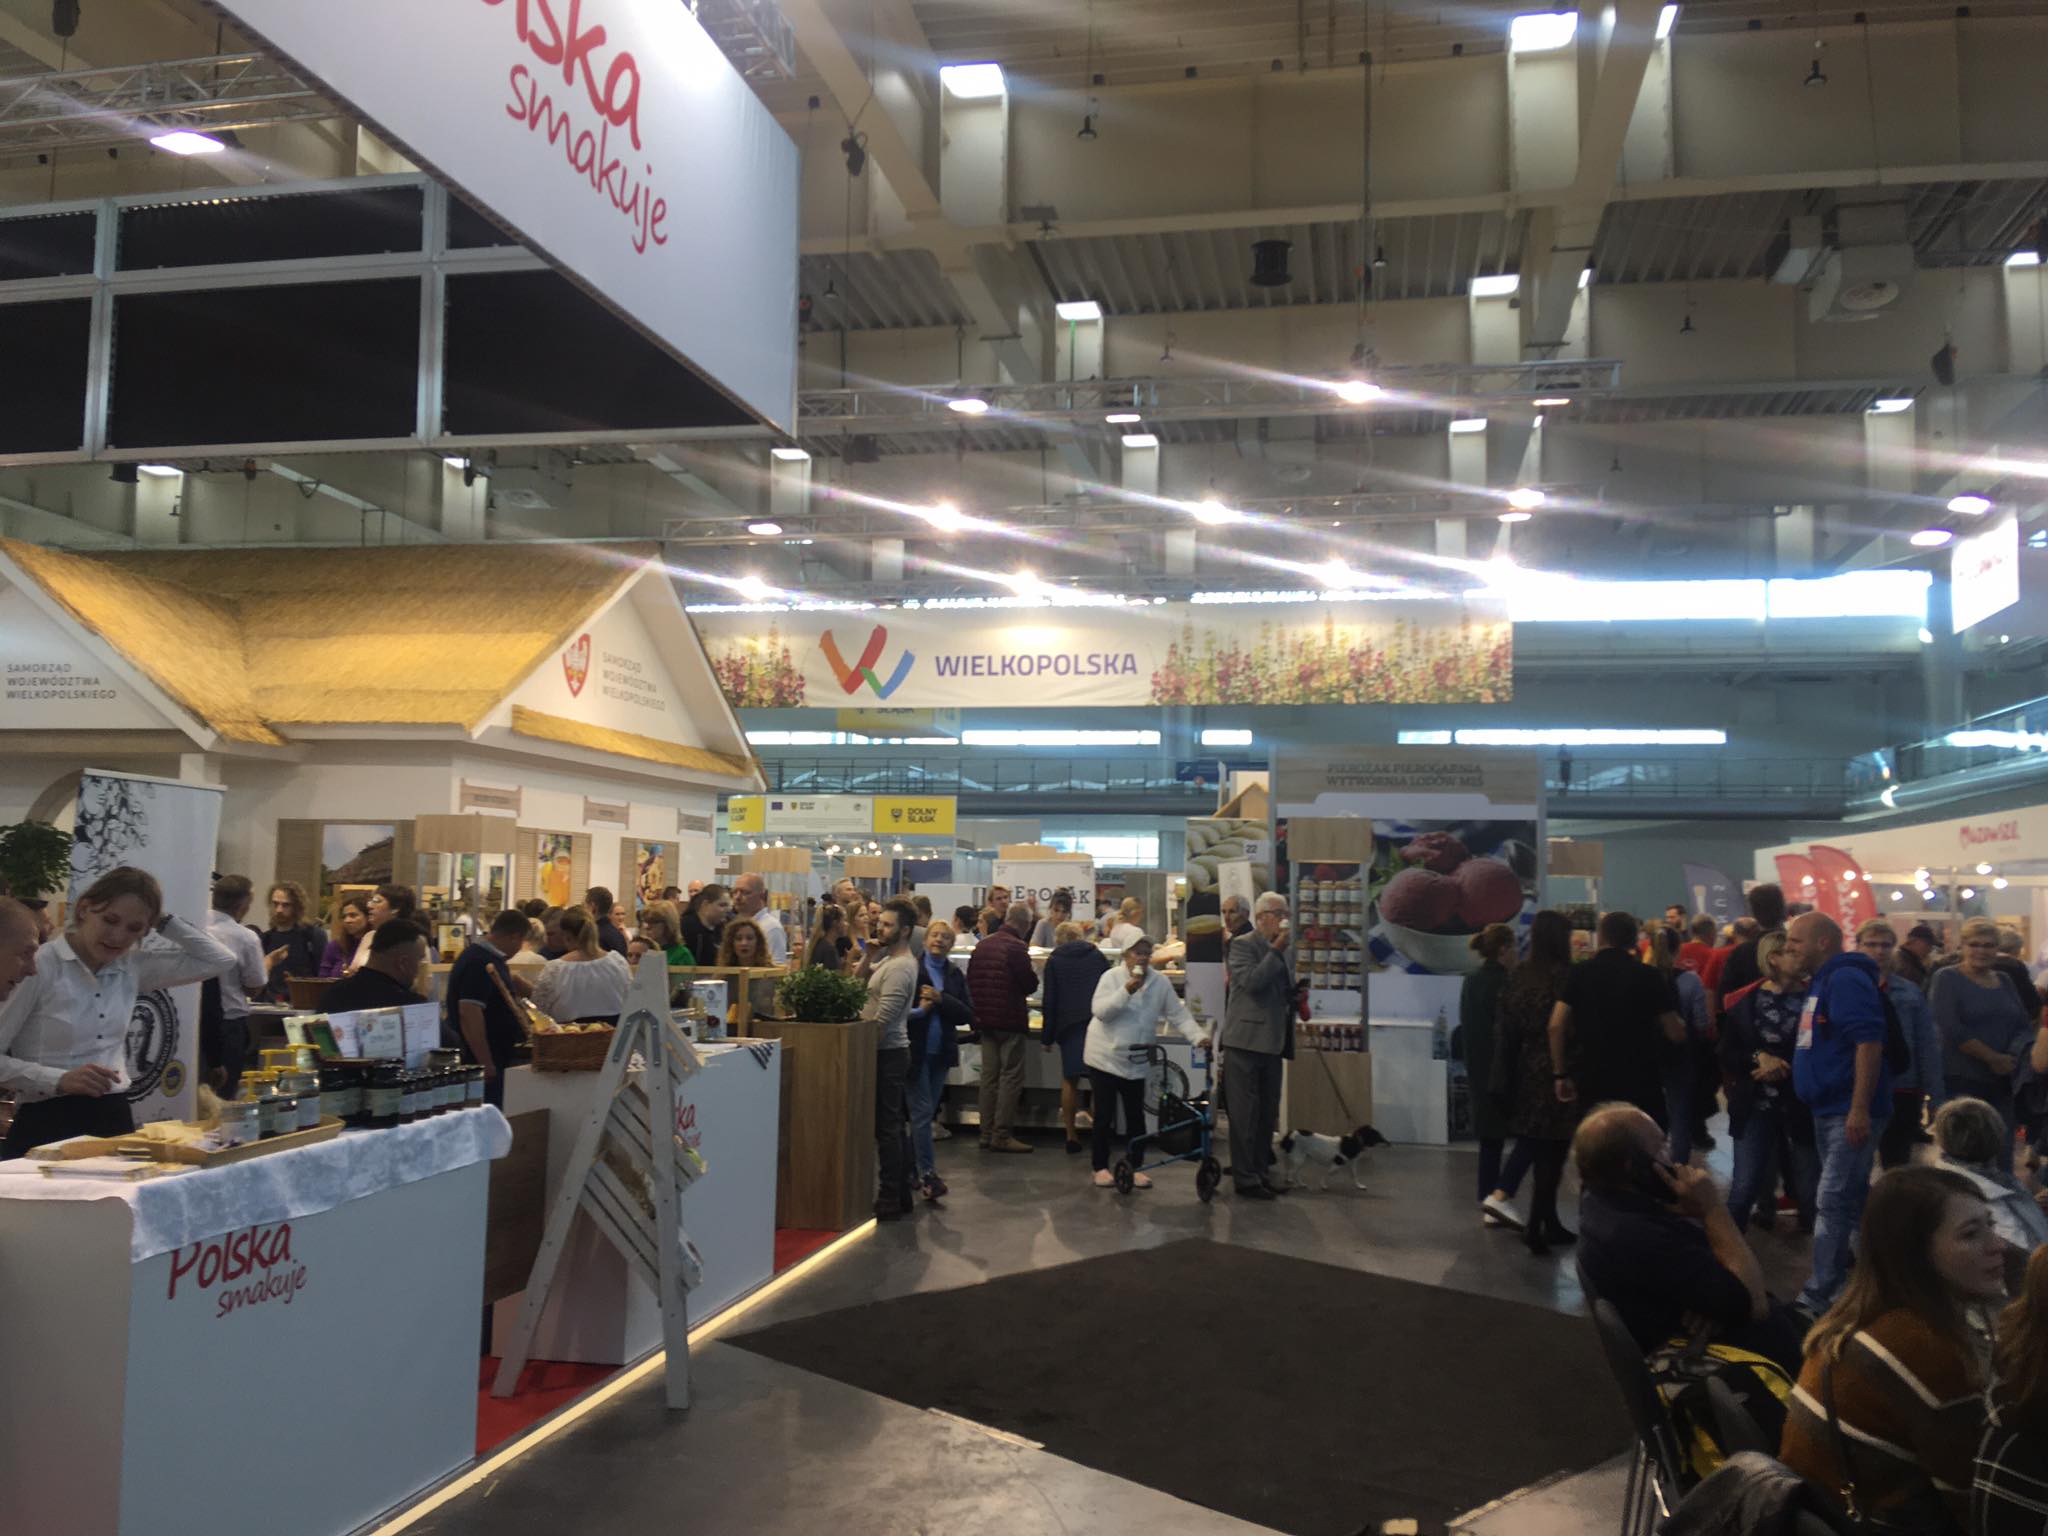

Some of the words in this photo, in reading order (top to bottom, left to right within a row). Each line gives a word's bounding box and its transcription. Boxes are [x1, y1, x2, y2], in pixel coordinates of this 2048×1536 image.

[506, 64, 668, 254] smakuje
[935, 653, 1138, 677] WIELKOPOLSKA
[6, 689, 117, 700] WIELKOPOLSKIEGO
[1245, 844, 1258, 854] 22
[167, 1223, 292, 1300] Polska
[215, 1258, 306, 1318] smakuje
